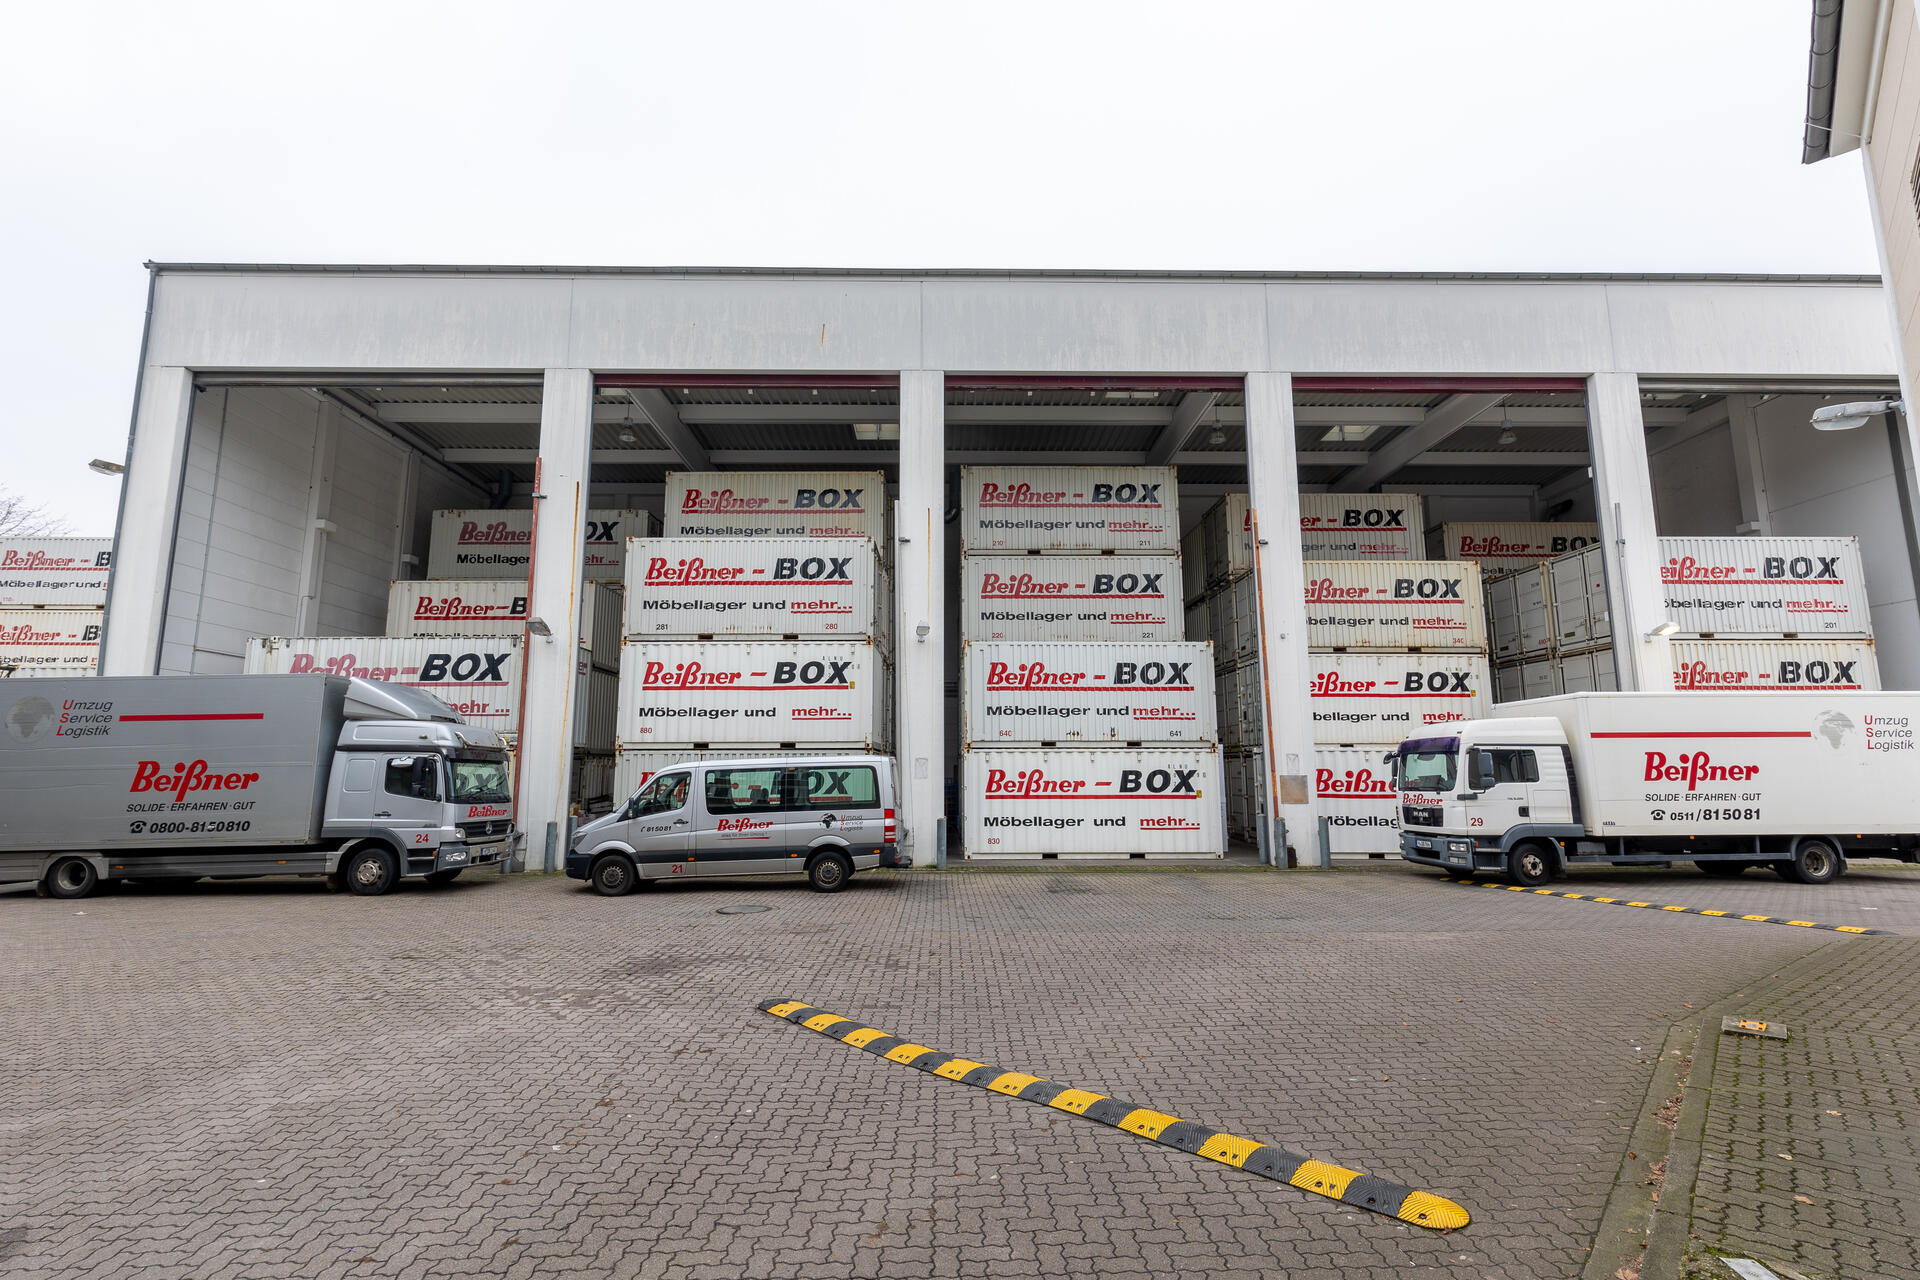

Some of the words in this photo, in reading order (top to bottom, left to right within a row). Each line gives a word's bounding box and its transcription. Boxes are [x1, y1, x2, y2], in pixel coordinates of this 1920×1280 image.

[682, 488, 769, 510] Beißner
[794, 488, 864, 509] BOX
[980, 482, 1066, 505] Beißner
[1092, 483, 1162, 503] BOX
[1343, 509, 1405, 527] BOX
[587, 521, 620, 541] OX
[680, 525, 771, 538] Möbellager
[776, 525, 805, 535] und
[809, 525, 865, 535] mehr...
[980, 519, 1069, 531] Möbellager
[1076, 519, 1105, 529] und
[1107, 519, 1163, 529] mehr...
[1330, 542, 1356, 551] und
[1360, 542, 1409, 551] mehr...
[1460, 536, 1530, 556] Beißner
[1, 550, 75, 569] Beißner
[645, 557, 745, 583] Beißner
[773, 557, 852, 580] BOX
[1660, 556, 1736, 580] eißner
[1764, 557, 1840, 579] BOX
[981, 573, 1068, 596] Beißner
[1093, 573, 1164, 594] BOX
[1304, 578, 1369, 601] eißner
[1394, 578, 1462, 599] BOX
[415, 596, 495, 616] Beißner
[642, 600, 746, 612] Möbellager
[752, 600, 786, 610] und
[791, 600, 852, 610] mehr...
[1665, 599, 1745, 611] bellager
[1751, 599, 1783, 609] und
[1786, 599, 1848, 609] mehr...
[980, 611, 1072, 623] Möbellager
[1078, 611, 1107, 621] und
[1110, 611, 1165, 621] mehr...
[1308, 616, 1374, 627] bellager
[1379, 616, 1409, 626] und
[1413, 617, 1467, 626] mehr...
[0, 624, 61, 644] eißner
[0, 656, 59, 664] bellager
[419, 653, 511, 681] BOX
[642, 661, 742, 688] Beißner
[773, 661, 852, 684] BOX
[987, 662, 1086, 687] Beißner
[1113, 662, 1192, 684] BOX
[1674, 661, 1748, 687] eißner
[1779, 661, 1857, 683] BOX
[1309, 672, 1376, 694] eißner
[1404, 672, 1471, 692] BOX
[63, 699, 113, 712] Umzug
[986, 706, 1091, 718] Möbellager
[1096, 706, 1129, 716] und
[1133, 706, 1196, 716] mehr...
[60, 712, 113, 724] Service
[639, 707, 739, 719] Möbellager
[744, 707, 776, 717] und
[792, 707, 852, 717] mehr...
[1313, 711, 1376, 723] bellager
[1382, 711, 1409, 721] und
[1865, 715, 1909, 728] Umzug
[56, 725, 110, 738] Logistik
[1866, 727, 1913, 738] Service
[1867, 739, 1915, 752] Logistik
[1644, 751, 1760, 791] Beißner
[129, 760, 260, 802] Beißner
[985, 769, 1086, 796] Beißner
[1119, 769, 1197, 793] BOX
[1316, 769, 1396, 793] Beißn
[1402, 793, 1443, 806] Beißner
[467, 805, 508, 818] Beißner
[717, 817, 774, 832] Beißner
[984, 816, 1084, 829] Möbellager
[1093, 816, 1126, 827] und
[1140, 816, 1200, 826] mehr...
[1471, 818, 1484, 826] 29
[416, 833, 429, 843] 24
[672, 864, 683, 873] 21
